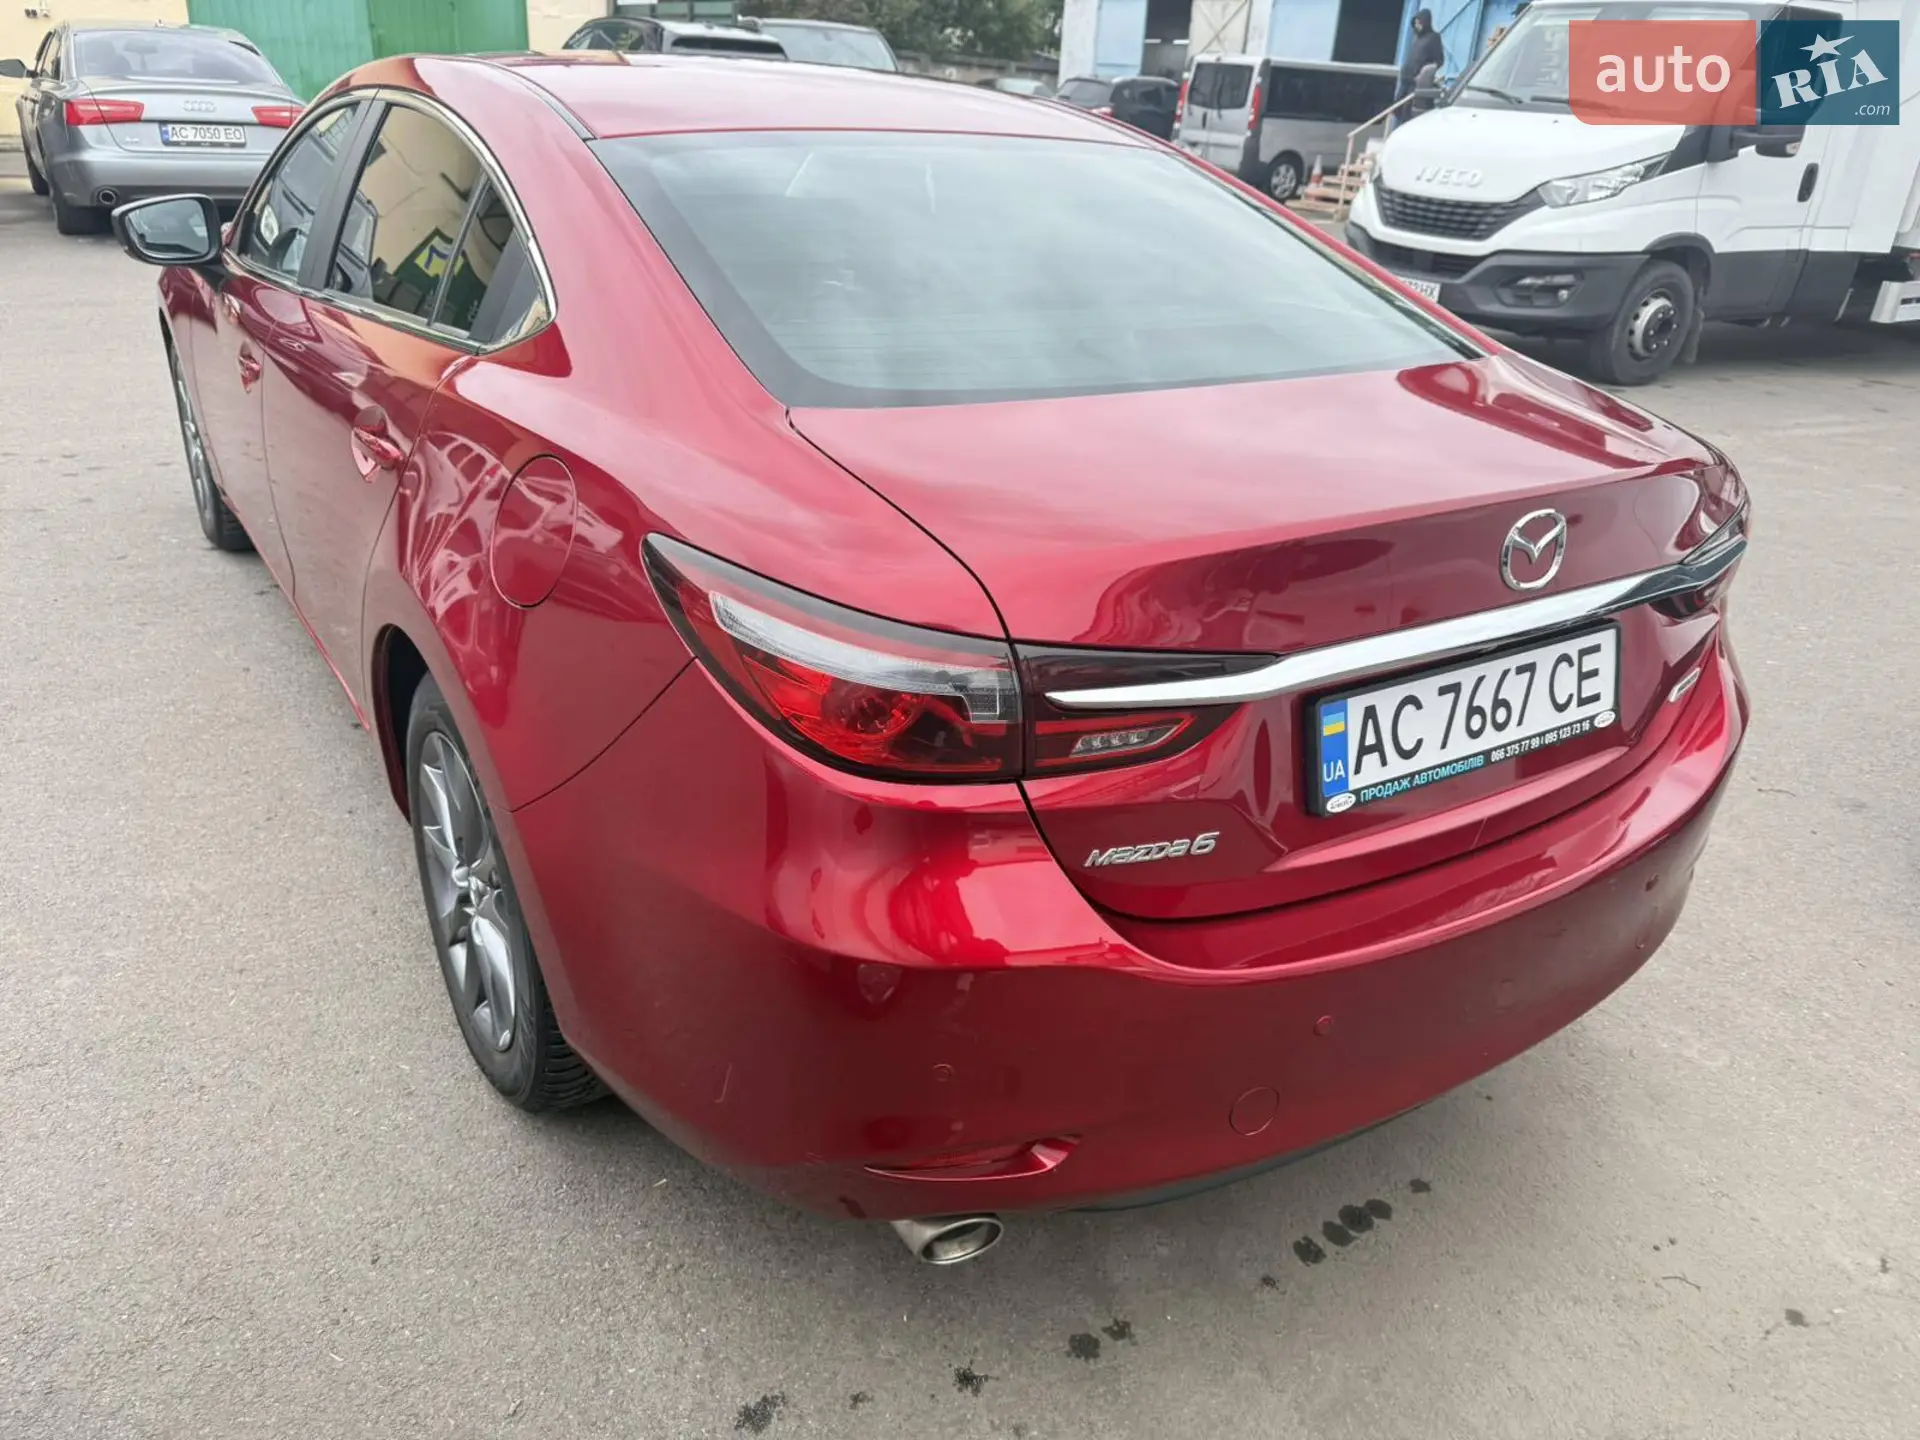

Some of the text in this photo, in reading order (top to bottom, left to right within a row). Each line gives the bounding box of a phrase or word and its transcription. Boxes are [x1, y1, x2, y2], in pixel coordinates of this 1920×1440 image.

[171, 126, 189, 139] AC
[192, 127, 221, 140] 7050
[1415, 166, 1483, 188] IVECO
[1353, 643, 1602, 776] AC 7667 CE
[1323, 759, 1346, 783] UA
[1360, 776, 1411, 802] ПРОДАЖ
[1412, 754, 1485, 787] АВТОМОБІЛІВ
